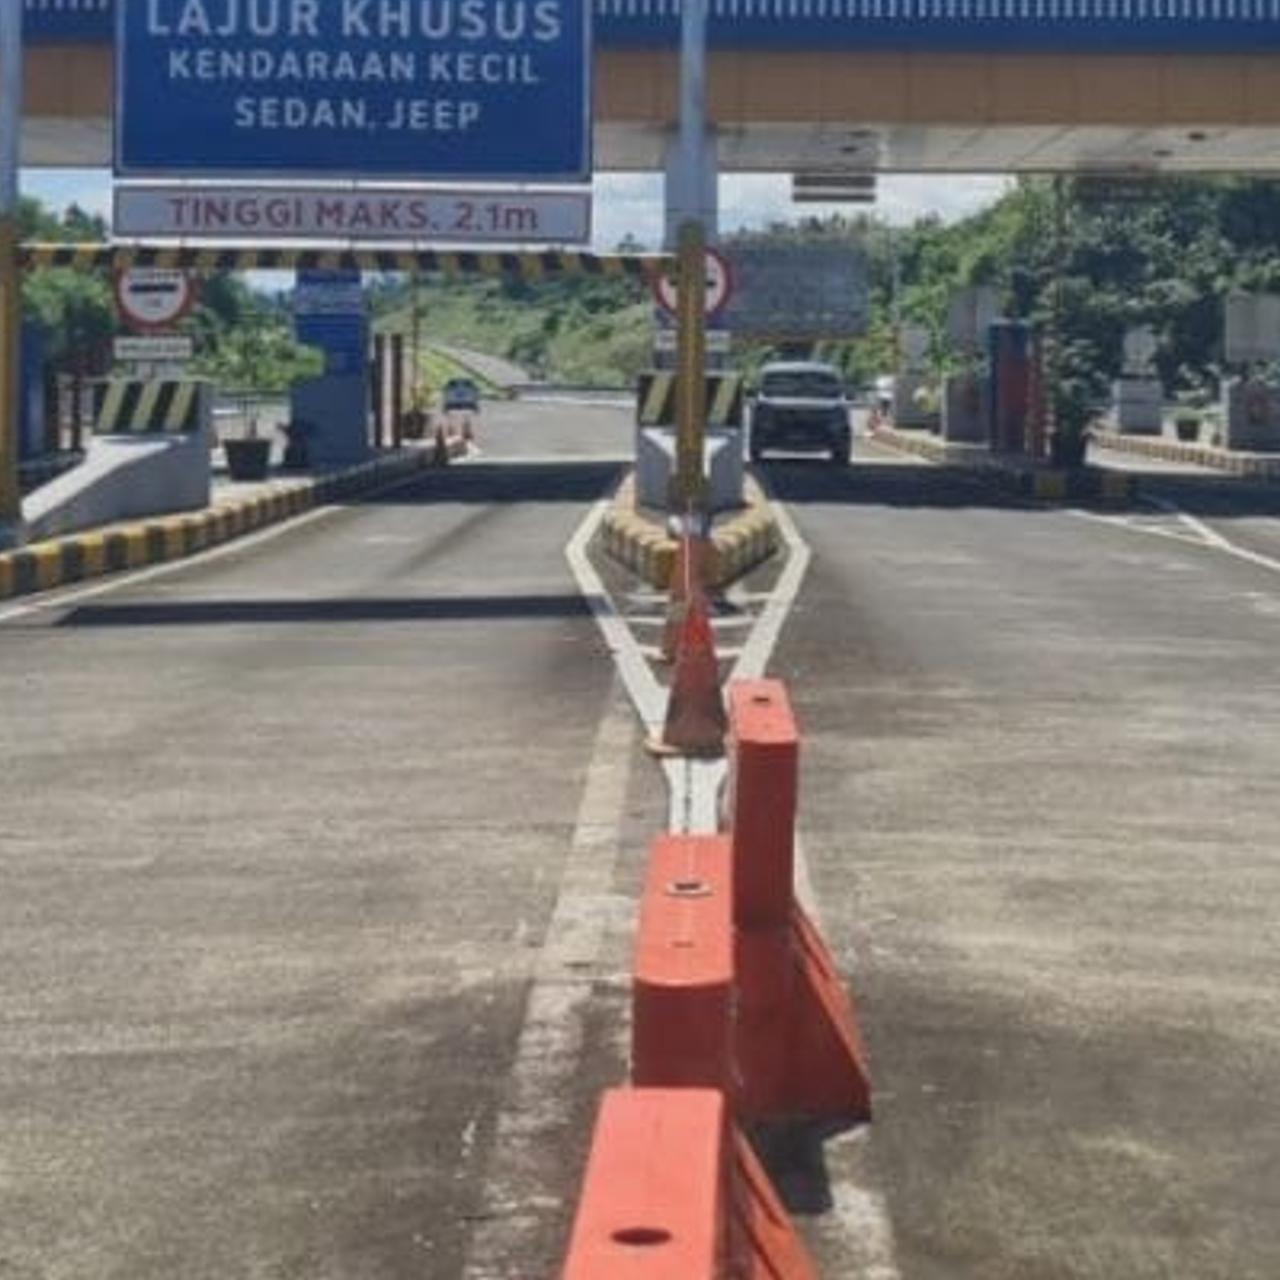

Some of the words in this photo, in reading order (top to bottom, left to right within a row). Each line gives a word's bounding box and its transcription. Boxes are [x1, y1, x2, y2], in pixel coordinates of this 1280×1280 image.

[169, 49, 416, 82] KENDARAAN
[428, 52, 540, 84] KECIL
[385, 99, 480, 131] JEEP
[168, 197, 302, 228] TINGGI
[311, 200, 440, 232] MAKS.
